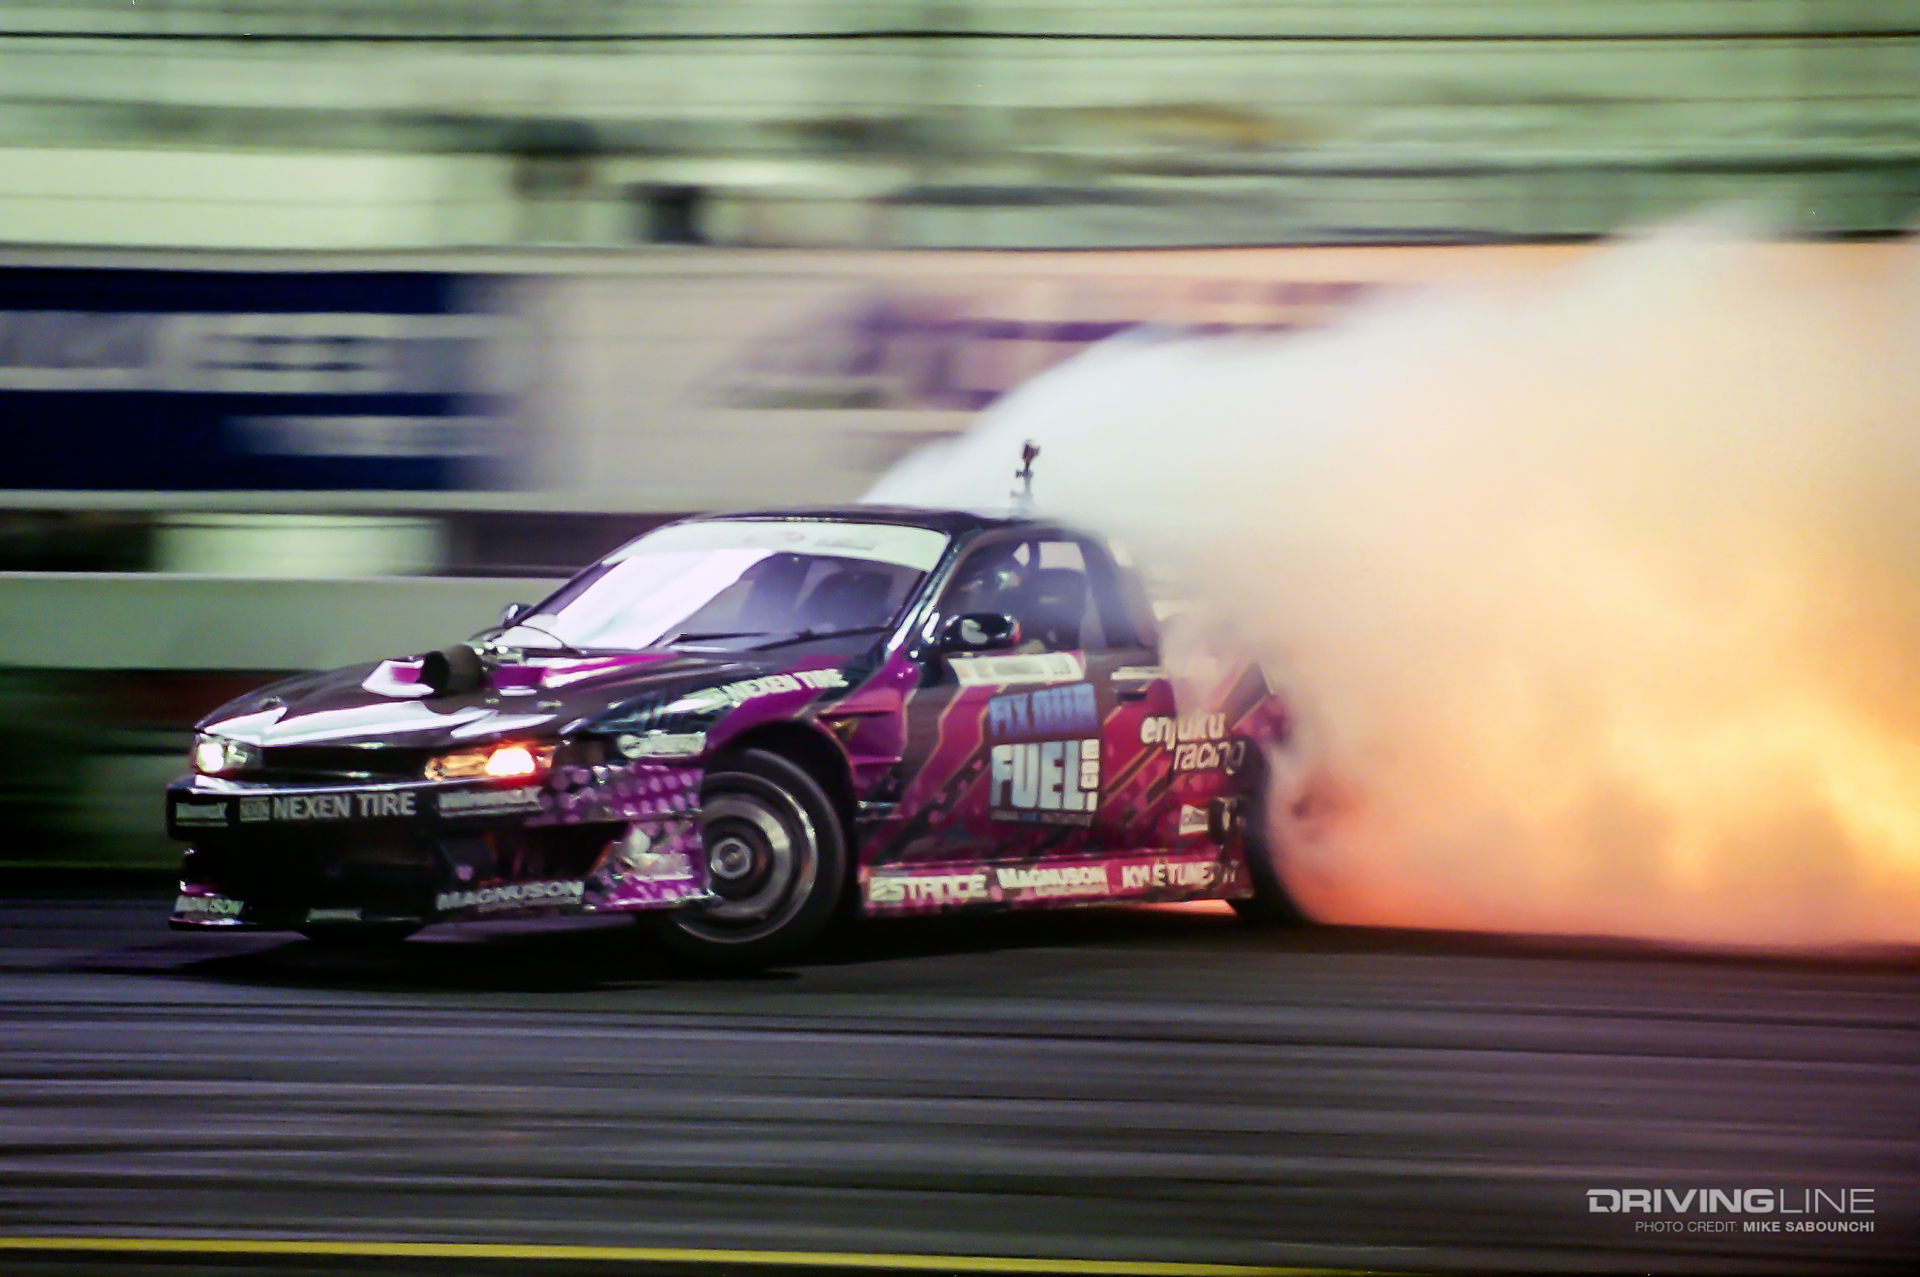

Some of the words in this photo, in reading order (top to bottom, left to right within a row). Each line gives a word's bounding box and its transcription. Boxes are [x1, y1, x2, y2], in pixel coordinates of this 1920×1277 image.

[989, 739, 1084, 812] FUEL
[273, 795, 351, 819] NEXEN
[356, 791, 417, 816] TIRE
